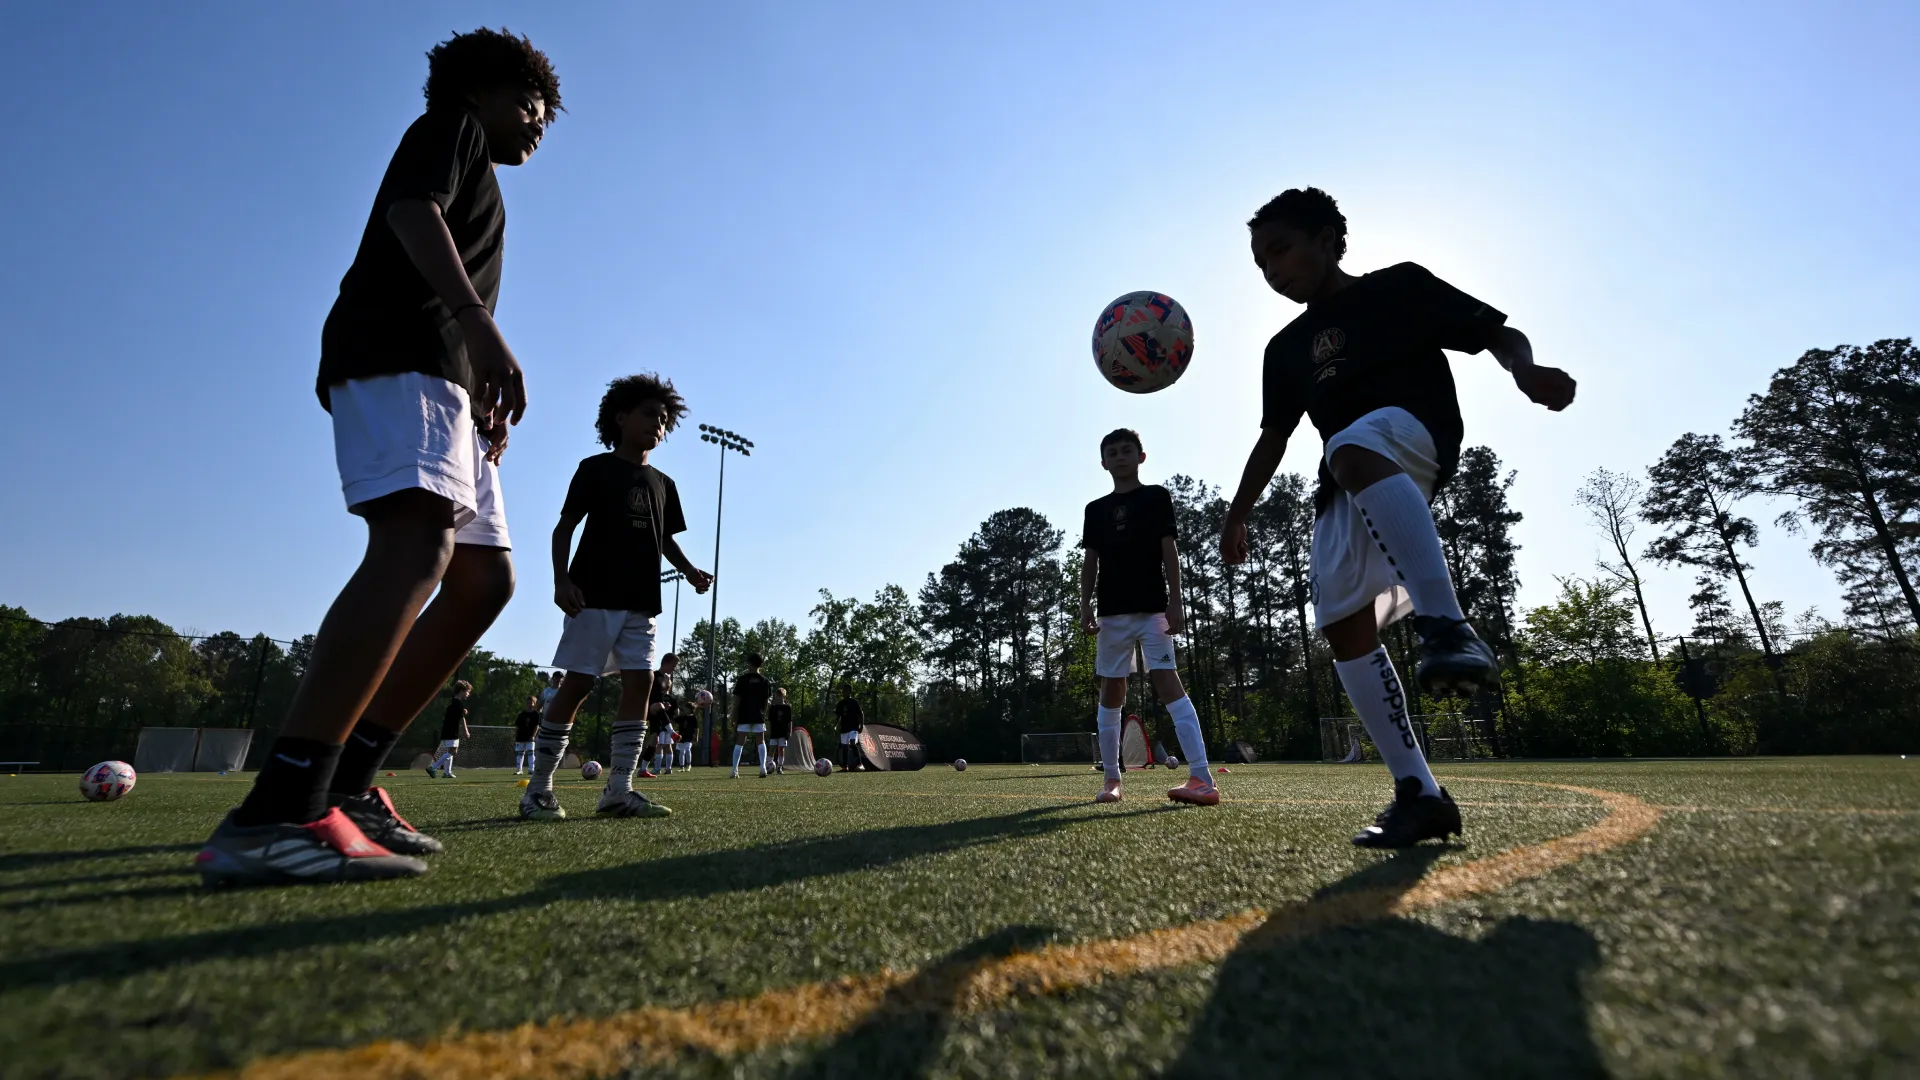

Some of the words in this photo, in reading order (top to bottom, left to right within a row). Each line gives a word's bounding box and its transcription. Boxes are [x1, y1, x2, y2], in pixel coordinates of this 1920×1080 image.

[632, 519, 648, 529] RDS
[1379, 668, 1415, 750] adidas
[878, 734, 907, 743] REGIONAL
[881, 742, 922, 751] DEVELOPMENT
[884, 750, 908, 759] SCHOOL
